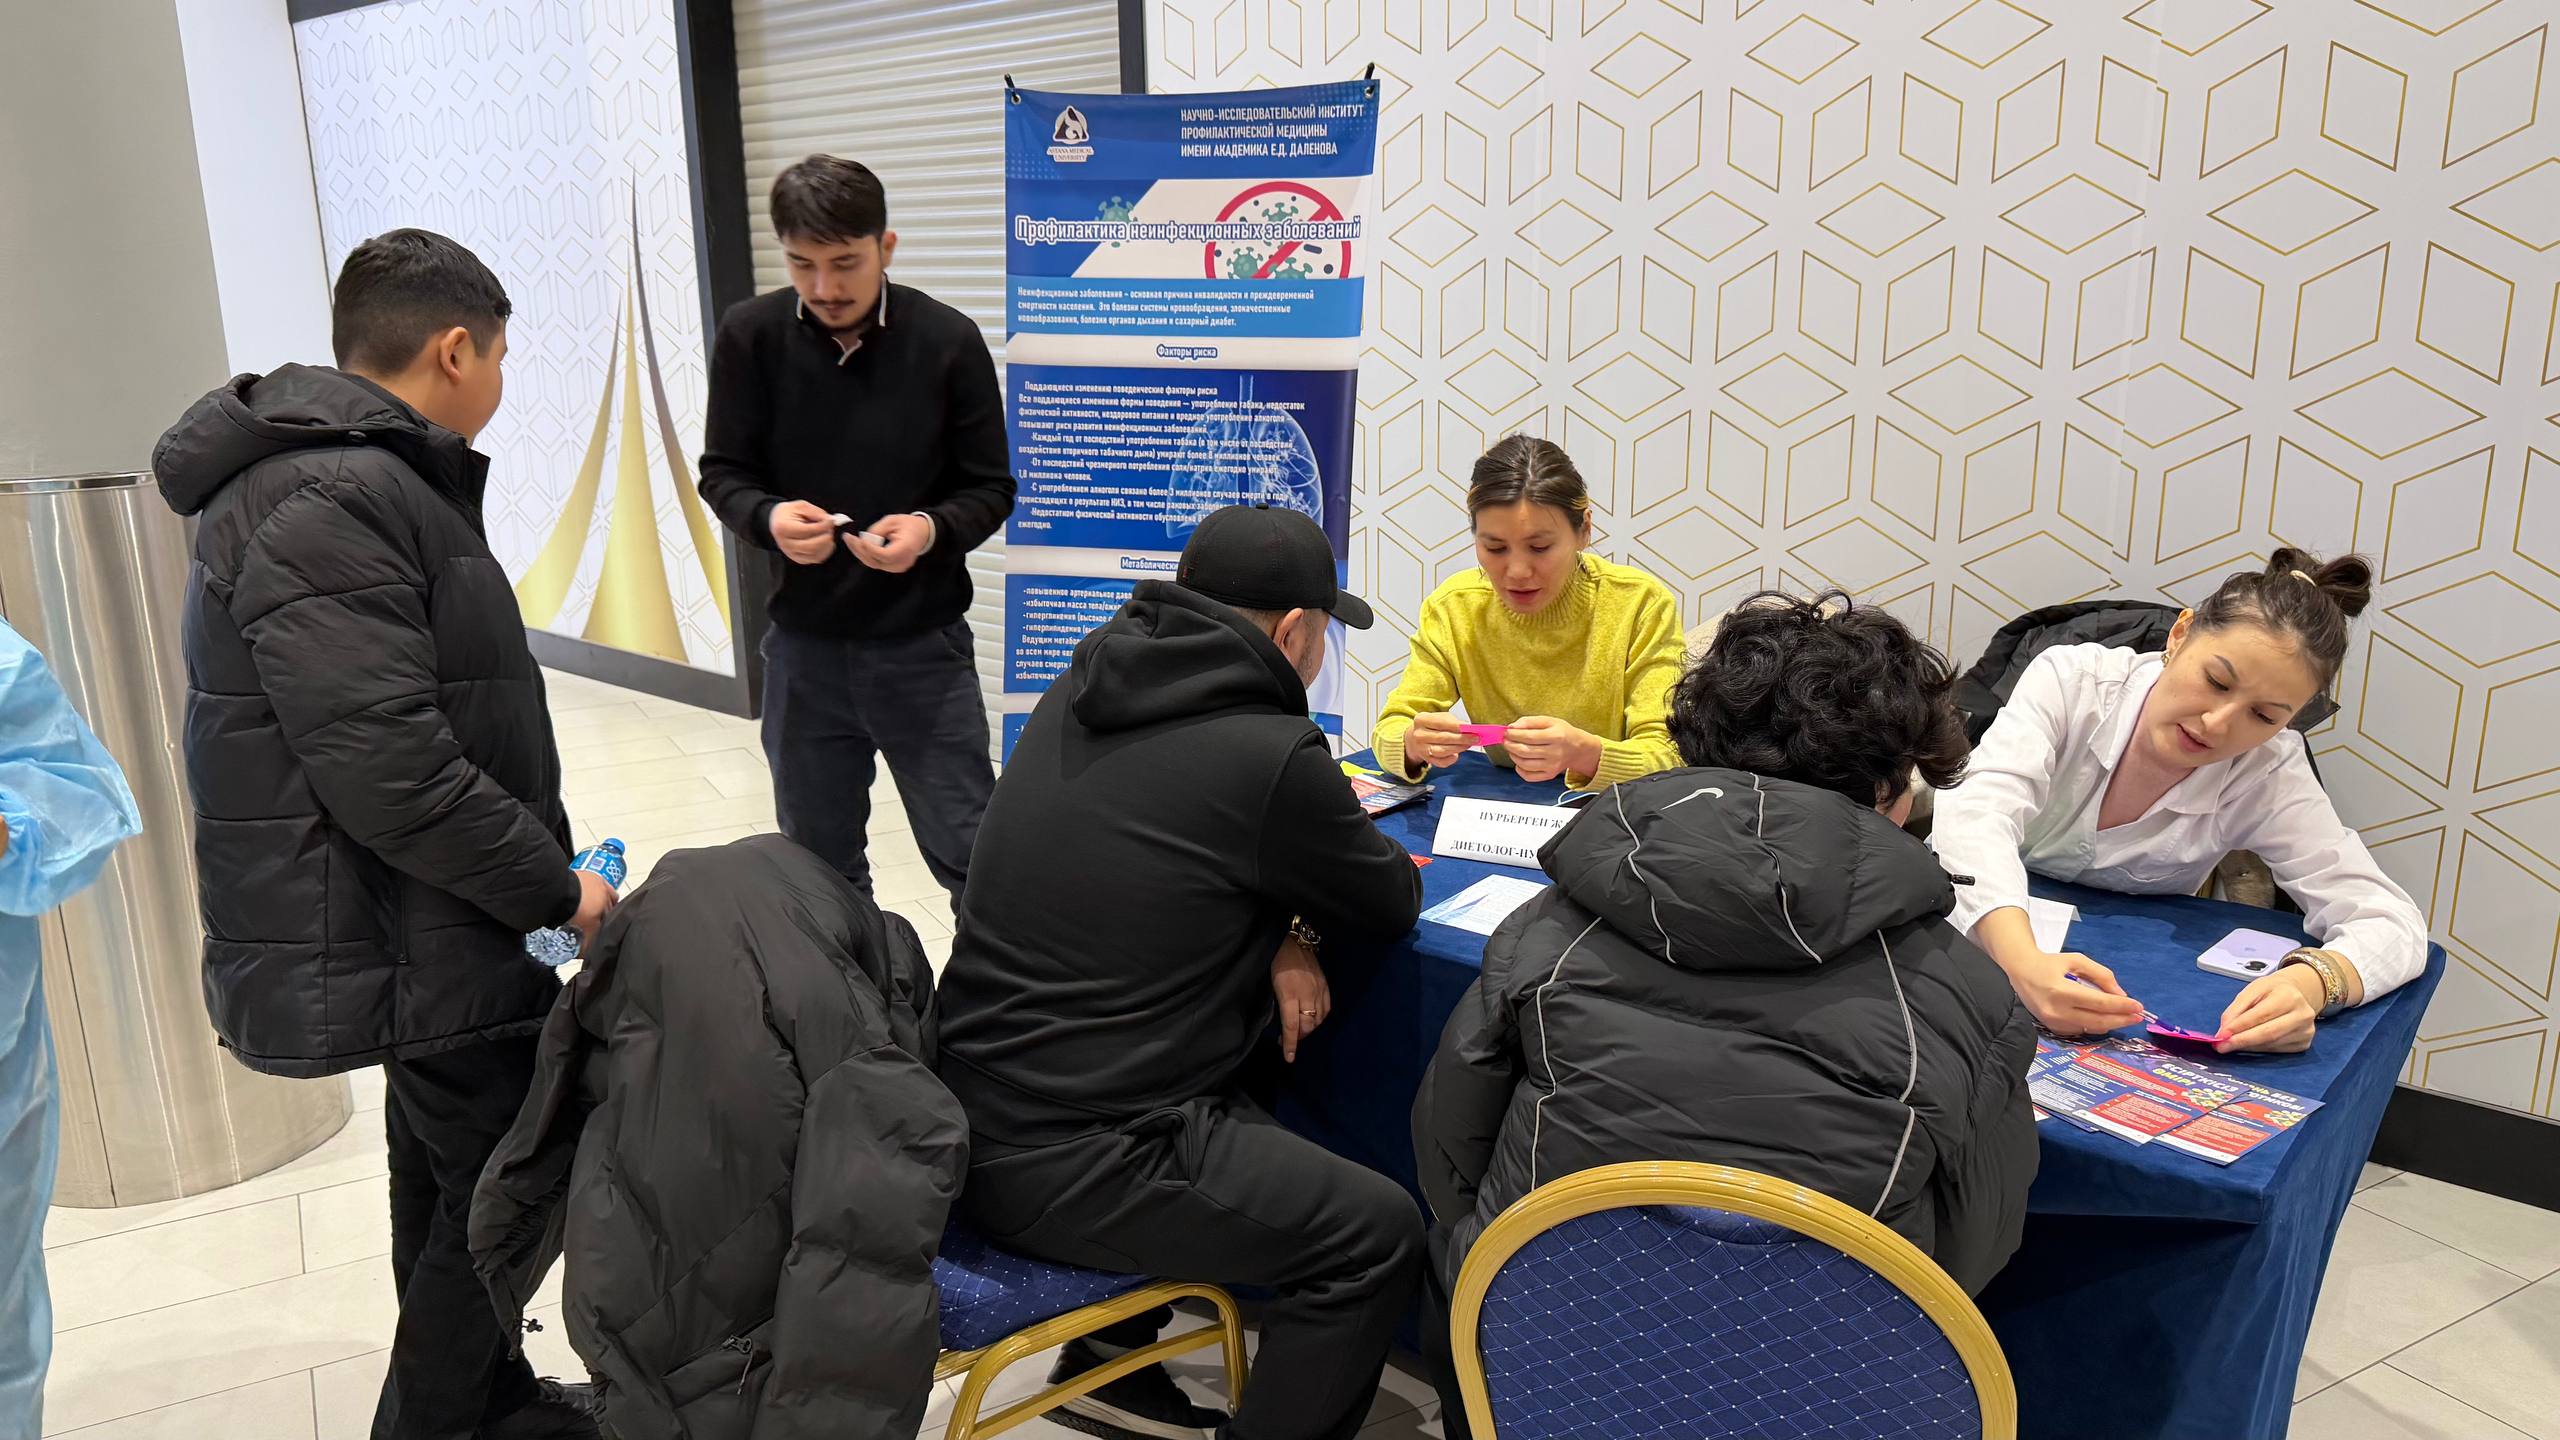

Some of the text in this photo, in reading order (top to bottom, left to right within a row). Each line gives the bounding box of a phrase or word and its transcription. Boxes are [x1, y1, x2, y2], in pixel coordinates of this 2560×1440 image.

[1181, 104, 1364, 122] НАУЧНО-ИССЛЕДОВАТЕЛЬСКИЙ ИНСТИТУТ
[1181, 124, 1328, 139] ПРОФИЛАКТИЧЕСКОЙ МЕДИЦИНЫ
[1181, 142, 1338, 158] ИМЕНИ АКАДЕМИКА Е.Д. ДАЛЕНОВА
[1018, 216, 1360, 243] Профилактика неинфекционных заболеваний
[1018, 287, 1078, 298] Неинфекционные
[1080, 288, 1122, 298] заболевания
[1164, 292, 1192, 300] причина
[1194, 292, 1242, 300] инвалидности
[1250, 290, 1314, 301] преждевременной
[1018, 302, 1056, 312] смертности
[1099, 302, 1110, 311] Это
[1112, 302, 1138, 312] болезни
[1140, 304, 1168, 312] системы
[1170, 303, 1229, 314] кровообращения,
[1231, 305, 1290, 313] злокачественные
[1081, 314, 1107, 324] болезни
[1108, 317, 1135, 326] органов
[1137, 318, 1167, 326] дыхания
[1175, 316, 1208, 328] сахарный
[1210, 316, 1236, 326] диабет.
[1157, 344, 1217, 360] Факторы риска
[1025, 381, 1073, 392] Поддающиеся
[1166, 386, 1196, 396] факторы
[1197, 388, 1218, 396] риска
[1018, 394, 1031, 403] Все
[1033, 396, 1080, 405] поддающиеся
[1082, 398, 1118, 406] изменению
[1120, 398, 1144, 408] формы
[1146, 399, 1181, 408] поведения
[1191, 399, 1238, 410] употребление
[1266, 402, 1305, 410] недостаток
[1018, 408, 1060, 417] физической
[1102, 412, 1140, 420] нездоровое
[1142, 412, 1169, 420] питание
[1176, 413, 1204, 422] вредное
[1206, 412, 1252, 422] употребление
[1018, 420, 1054, 428] повышают
[1056, 422, 1072, 431] риск
[1104, 423, 1162, 432] неинфекционных
[1062, 435, 1074, 443] год
[1084, 434, 1124, 444] последствий
[1126, 436, 1172, 446] употребления
[1173, 437, 1196, 446] табака
[1220, 440, 1240, 448] числе
[1018, 444, 1060, 454] воздействия
[1063, 448, 1098, 456] вторичного
[1100, 448, 1132, 458] табачного
[1157, 451, 1185, 460] умирают
[1187, 451, 1206, 460] более
[1214, 452, 1250, 460] миллионов
[1043, 458, 1084, 468] последствий
[1086, 462, 1126, 471] чрезмерного
[1128, 462, 1170, 472] потребления
[1029, 472, 1062, 480] миллиона
[1039, 483, 1088, 494] употреблением
[1090, 486, 1119, 494] алкоголя
[1120, 488, 1147, 496] связано
[1148, 486, 1168, 496] более
[1176, 490, 1211, 498] миллионов
[1213, 490, 1240, 500] случаев
[1242, 492, 1264, 500] смерти
[1074, 498, 1110, 507] результате
[1133, 500, 1144, 508] том
[1146, 501, 1165, 509] числе
[1076, 510, 1114, 520] физической
[1116, 513, 1153, 521] активности
[1120, 556, 1179, 572] Метаболически
[1070, 590, 1114, 598] артериальное
[1022, 634, 1052, 646] Ведущим
[1016, 648, 1024, 656] во
[1026, 648, 1042, 656] всем
[1044, 649, 1060, 658] мире
[1016, 660, 1043, 669] случаев
[1045, 661, 1068, 670] смерти
[1016, 670, 1056, 680] избыточная
[1480, 812, 1548, 828] НУРБЕРГЕН
[1450, 840, 1538, 859] ДИЕТОЛОГ-НУ
[2247, 1092, 2304, 1111] ОТИКОВ!
